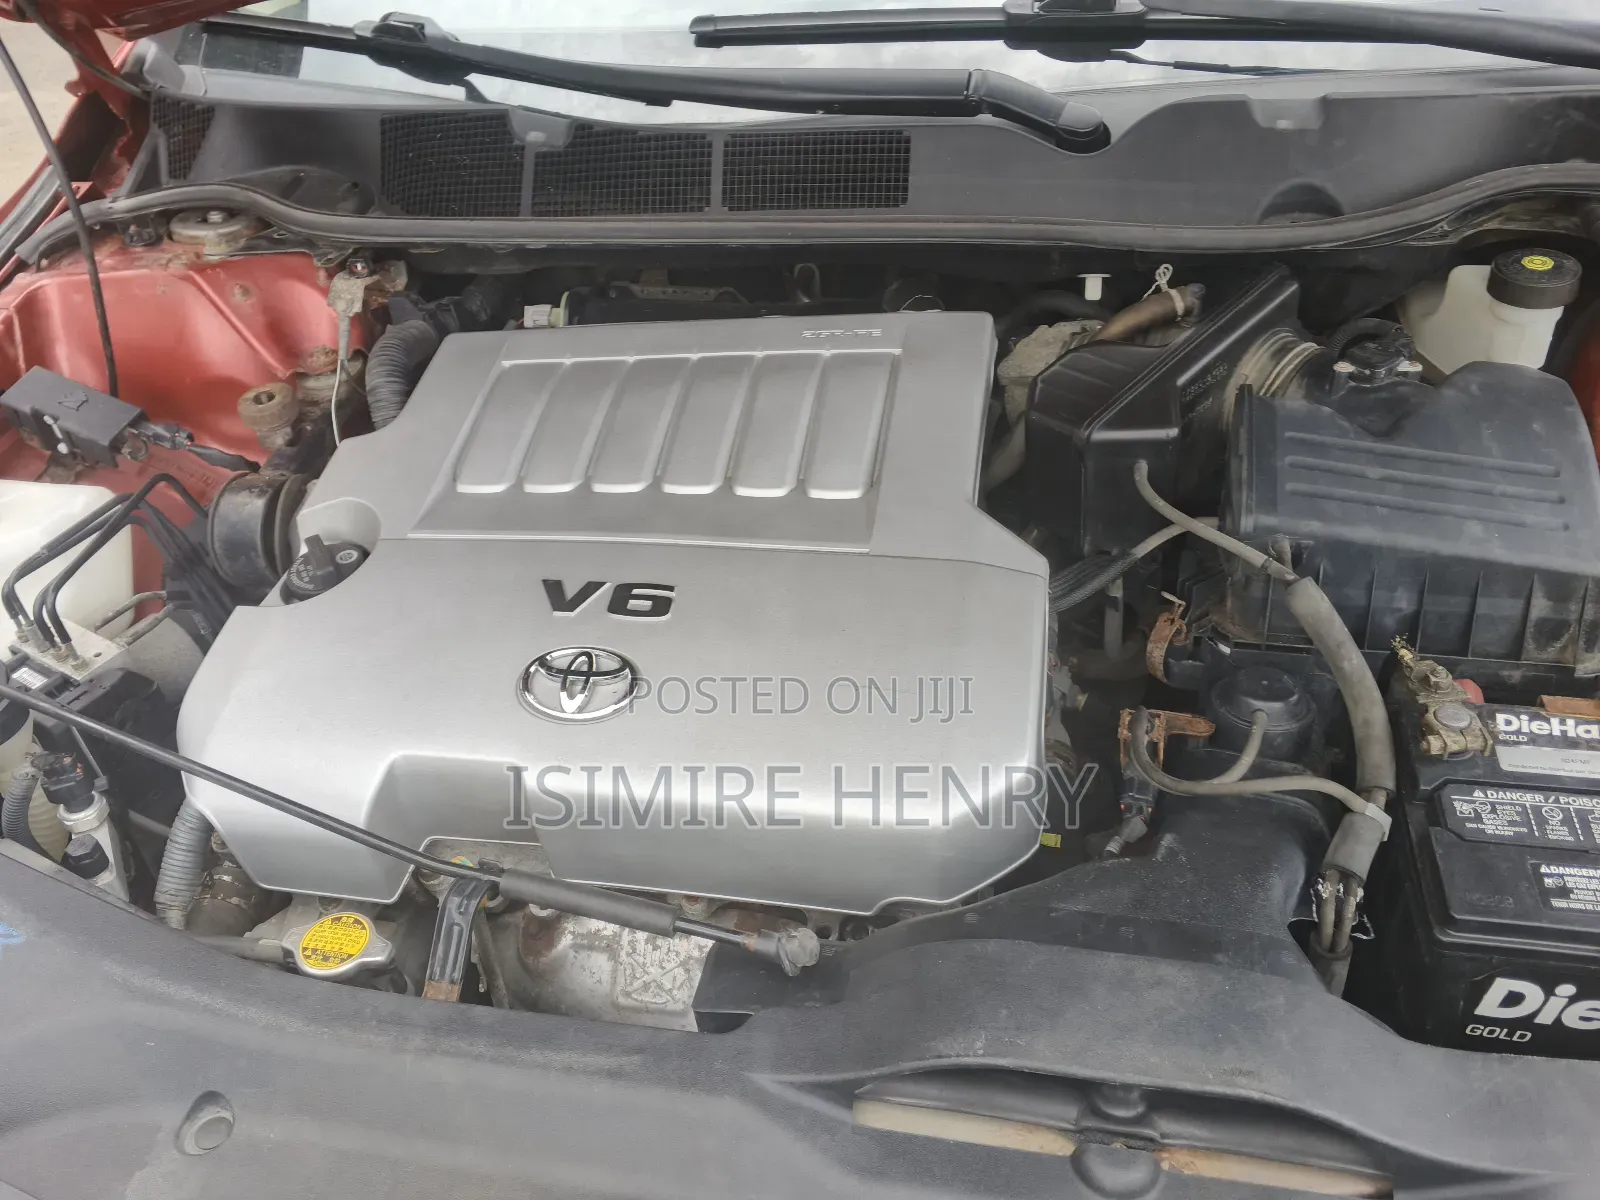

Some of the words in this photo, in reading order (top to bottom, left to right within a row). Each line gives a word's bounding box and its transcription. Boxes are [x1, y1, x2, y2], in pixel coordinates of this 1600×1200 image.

[541, 579, 676, 621] V6
[1495, 713, 1600, 739] DieHa
[1486, 790, 1545, 803] DANGER
[1473, 977, 1600, 1030] Die
[1465, 1024, 1533, 1042] GOLD
